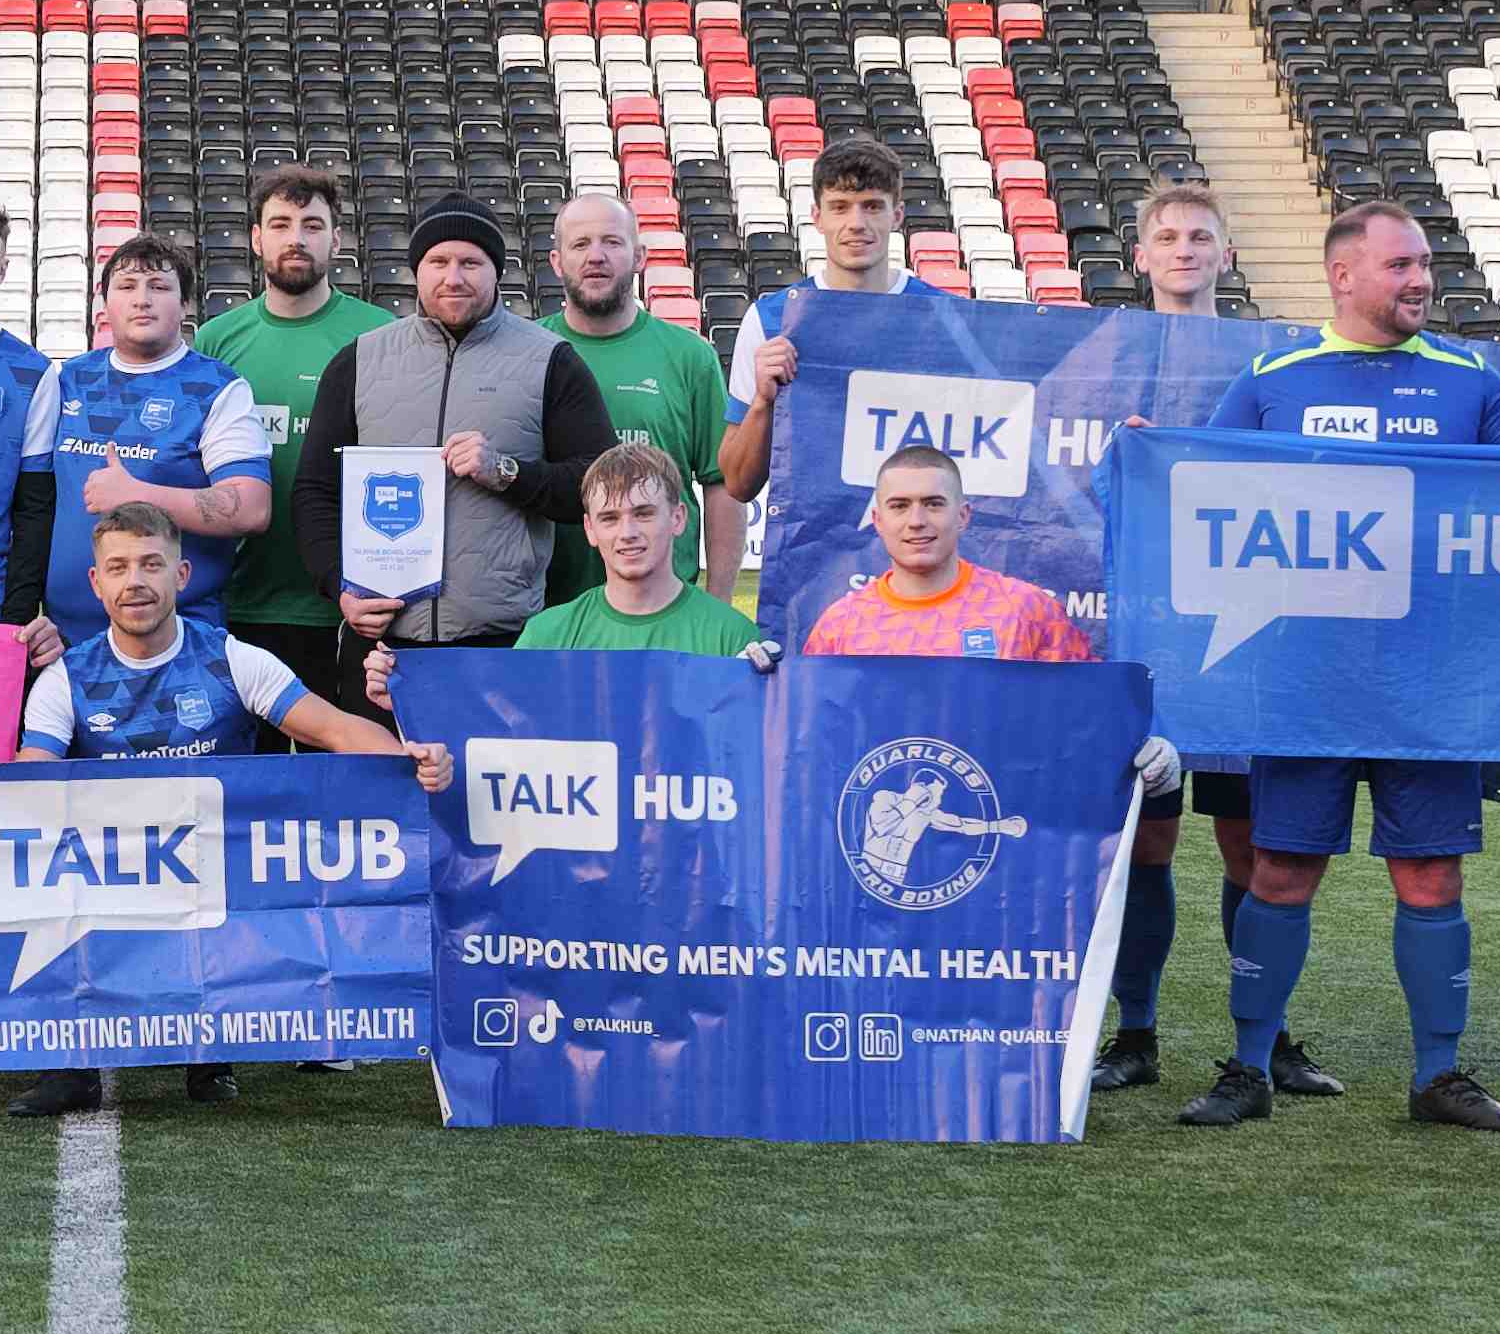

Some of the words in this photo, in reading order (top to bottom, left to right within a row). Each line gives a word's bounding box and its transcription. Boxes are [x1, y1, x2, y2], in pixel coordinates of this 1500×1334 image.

[867, 407, 1010, 461] TALK
[1310, 416, 1369, 434] TALK
[1386, 417, 1439, 435] HUB
[1196, 508, 1388, 572] TALK
[858, 745, 985, 788] QUARLESS
[481, 773, 601, 816] TALK
[633, 775, 738, 822] HUB
[0, 825, 200, 888] TALK
[250, 818, 407, 884] HUB
[854, 862, 895, 896] PRO
[900, 864, 978, 904] BOXING
[462, 933, 669, 975] SUPPORTING
[677, 946, 788, 977] MEN'S
[796, 947, 929, 979] MENTAL
[940, 948, 1077, 981] HEALTH
[138, 1011, 216, 1049] MEN'S
[221, 1010, 321, 1045] MENTAL
[326, 1007, 415, 1041] HEALTH
[911, 1027, 995, 1045] @NATHAN
